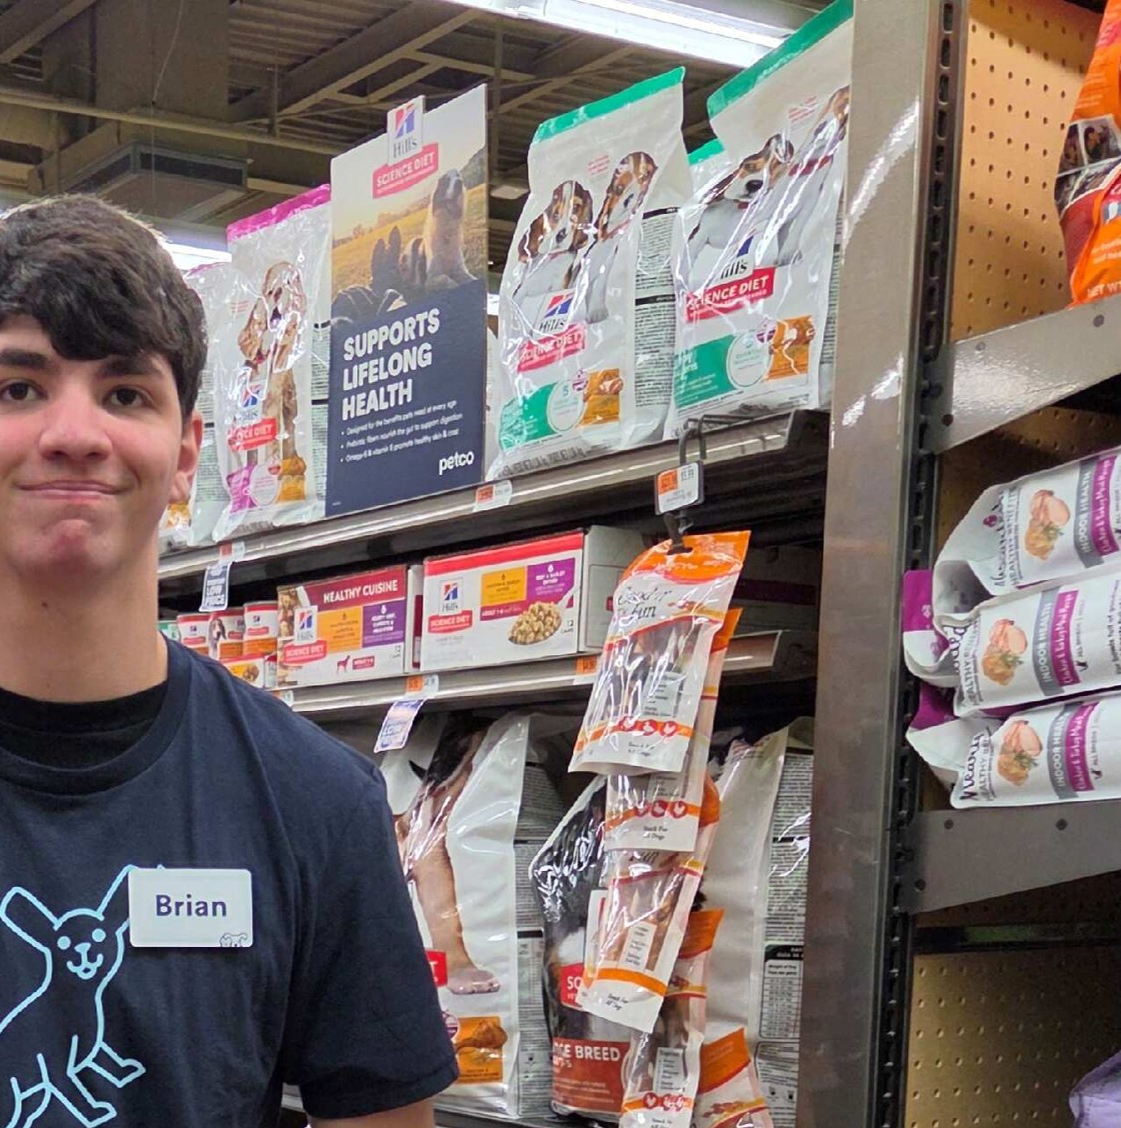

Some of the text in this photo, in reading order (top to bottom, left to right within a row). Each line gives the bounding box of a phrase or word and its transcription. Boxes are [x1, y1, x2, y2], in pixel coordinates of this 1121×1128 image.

[393, 137, 418, 159] Hill's
[376, 159, 414, 187] SCIENCE
[414, 150, 436, 171] DIET
[739, 275, 769, 296] DIET
[343, 308, 440, 361] SUPPORTS
[343, 342, 432, 391] LIFELONG
[342, 379, 412, 421] HEALTH
[439, 450, 475, 476] petco
[1080, 470, 1092, 512] HEALTH
[323, 579, 398, 604] HEALTHY CUISINE
[1038, 602, 1052, 683] INDOOR HEALTH
[1052, 751, 1066, 787] INDOOR
[156, 894, 228, 918] Brian
[575, 1045, 621, 1062] BREED
